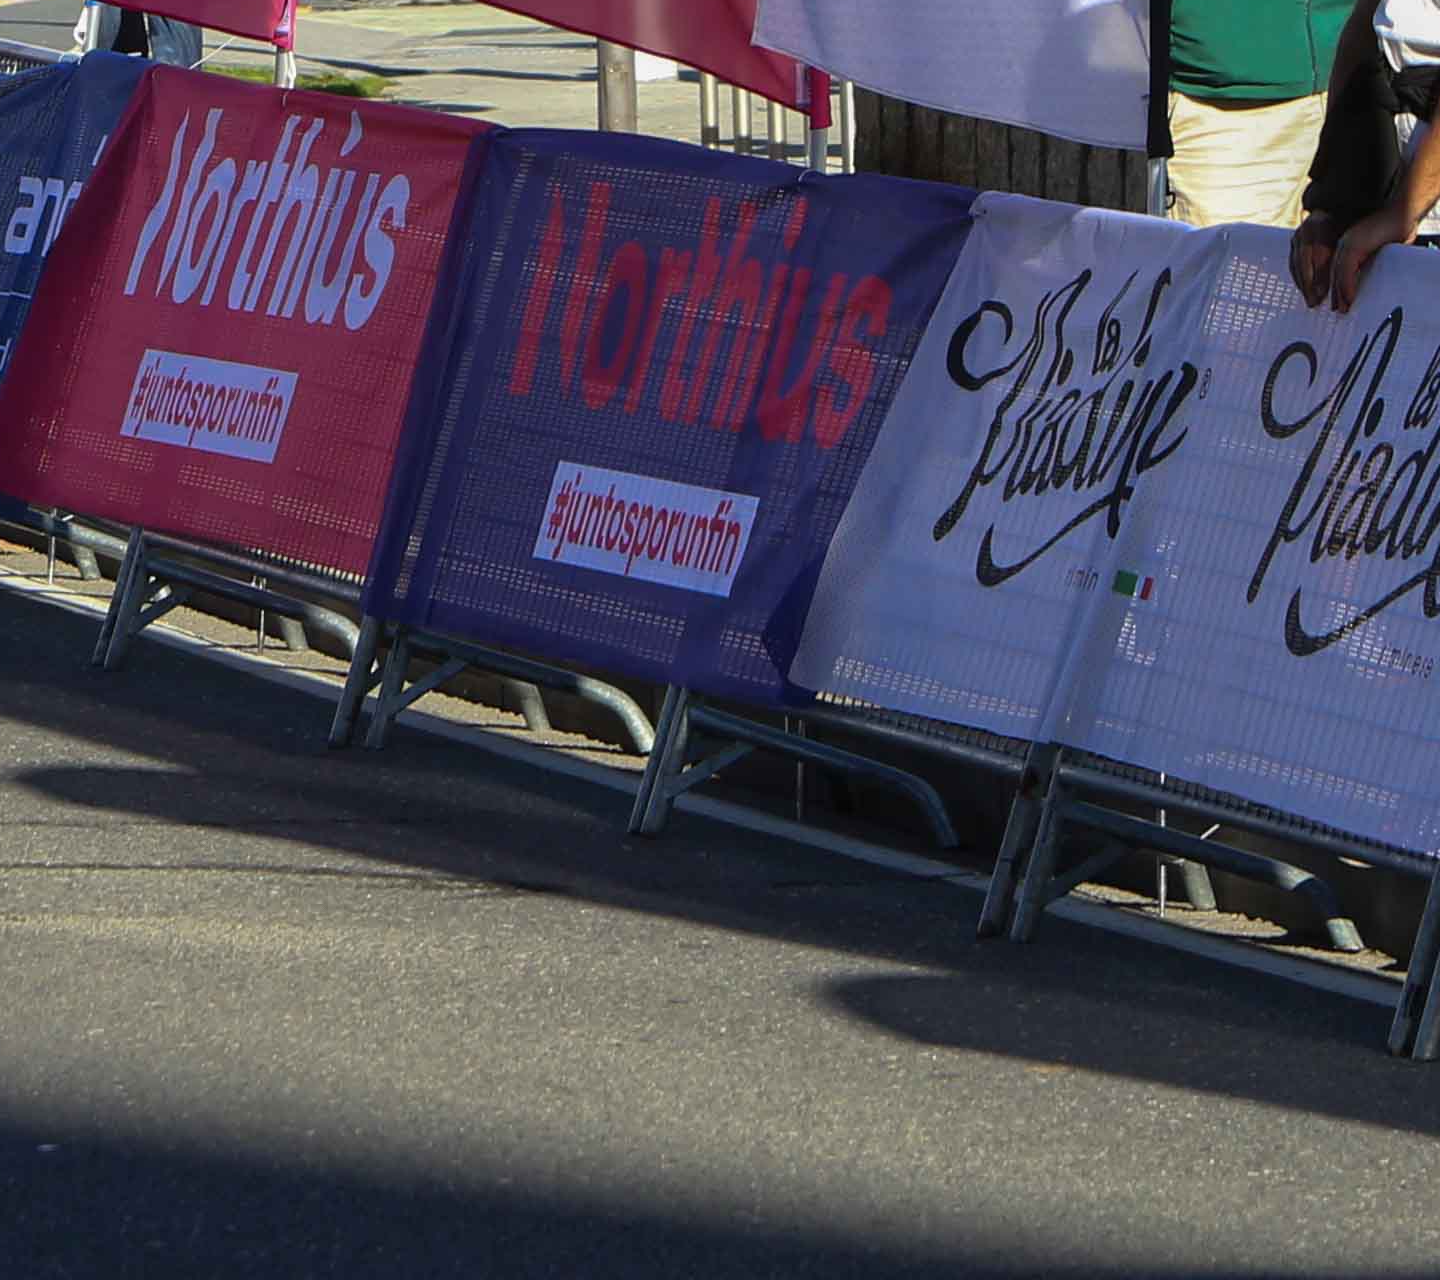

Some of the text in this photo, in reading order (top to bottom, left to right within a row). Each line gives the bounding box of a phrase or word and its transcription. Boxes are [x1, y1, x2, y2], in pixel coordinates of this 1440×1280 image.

[123, 110, 412, 331] Northius
[508, 183, 893, 451] Northius
[128, 357, 285, 448] #juntosporunfin
[548, 470, 744, 579] #juntosporunfin
